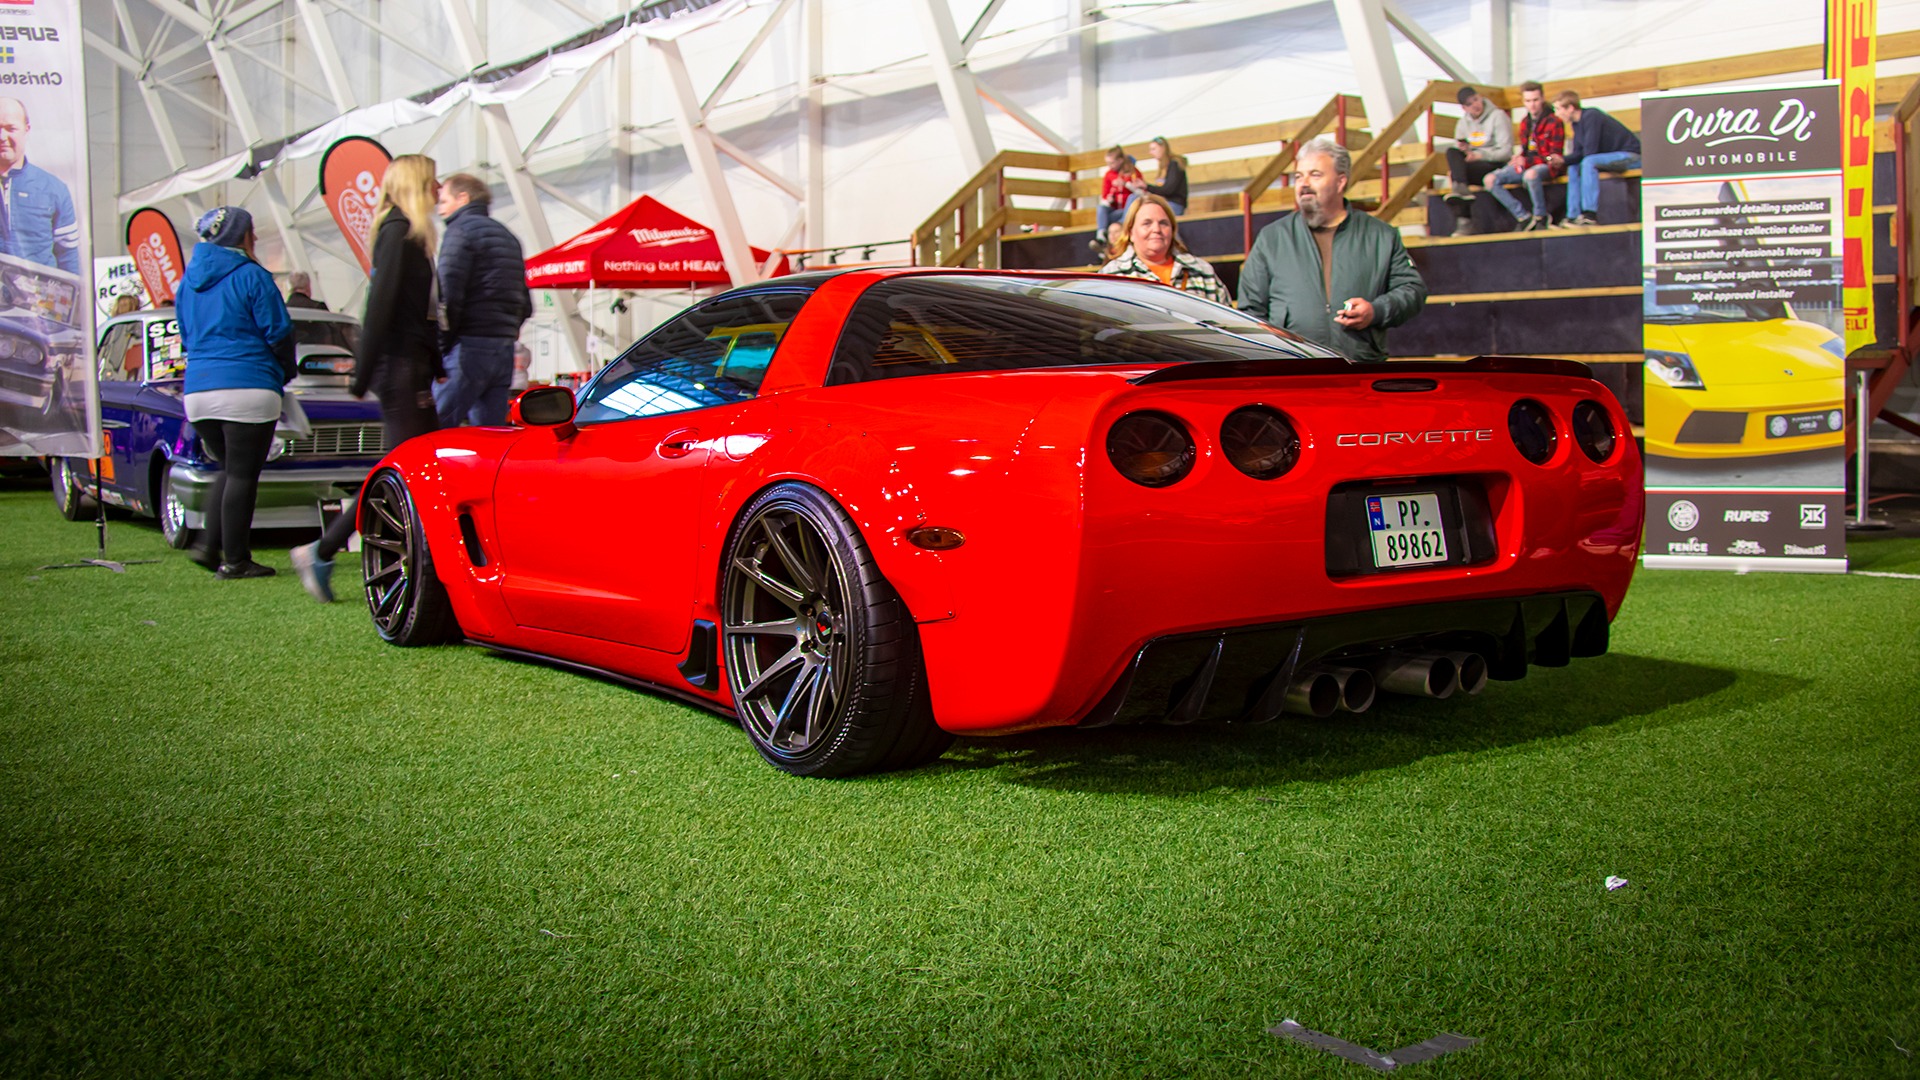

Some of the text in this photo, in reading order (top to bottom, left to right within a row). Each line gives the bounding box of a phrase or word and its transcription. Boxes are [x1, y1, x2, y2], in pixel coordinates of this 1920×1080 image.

[1666, 98, 1816, 144] Cura Di
[1685, 151, 1798, 166] AUTOMOBILE
[1661, 201, 1824, 217] Concours awarded detailing specialist
[628, 227, 708, 245] Milwaukee
[1662, 223, 1824, 239] Certified Kamikaze collection detailer
[1664, 246, 1822, 261] Fenice leather professionals Norway
[108, 262, 138, 279] HEL
[604, 260, 656, 273] Nothing
[659, 260, 681, 272] but
[1674, 268, 1812, 283] Rupes Bigfoot system specialist
[1691, 289, 1795, 303] Xpel approved installer
[1336, 429, 1493, 447] CORVETTE
[1398, 500, 1421, 527] PP
[1723, 510, 1769, 523] RUPES
[1374, 518, 1381, 526] N
[1386, 531, 1443, 562] 89862
